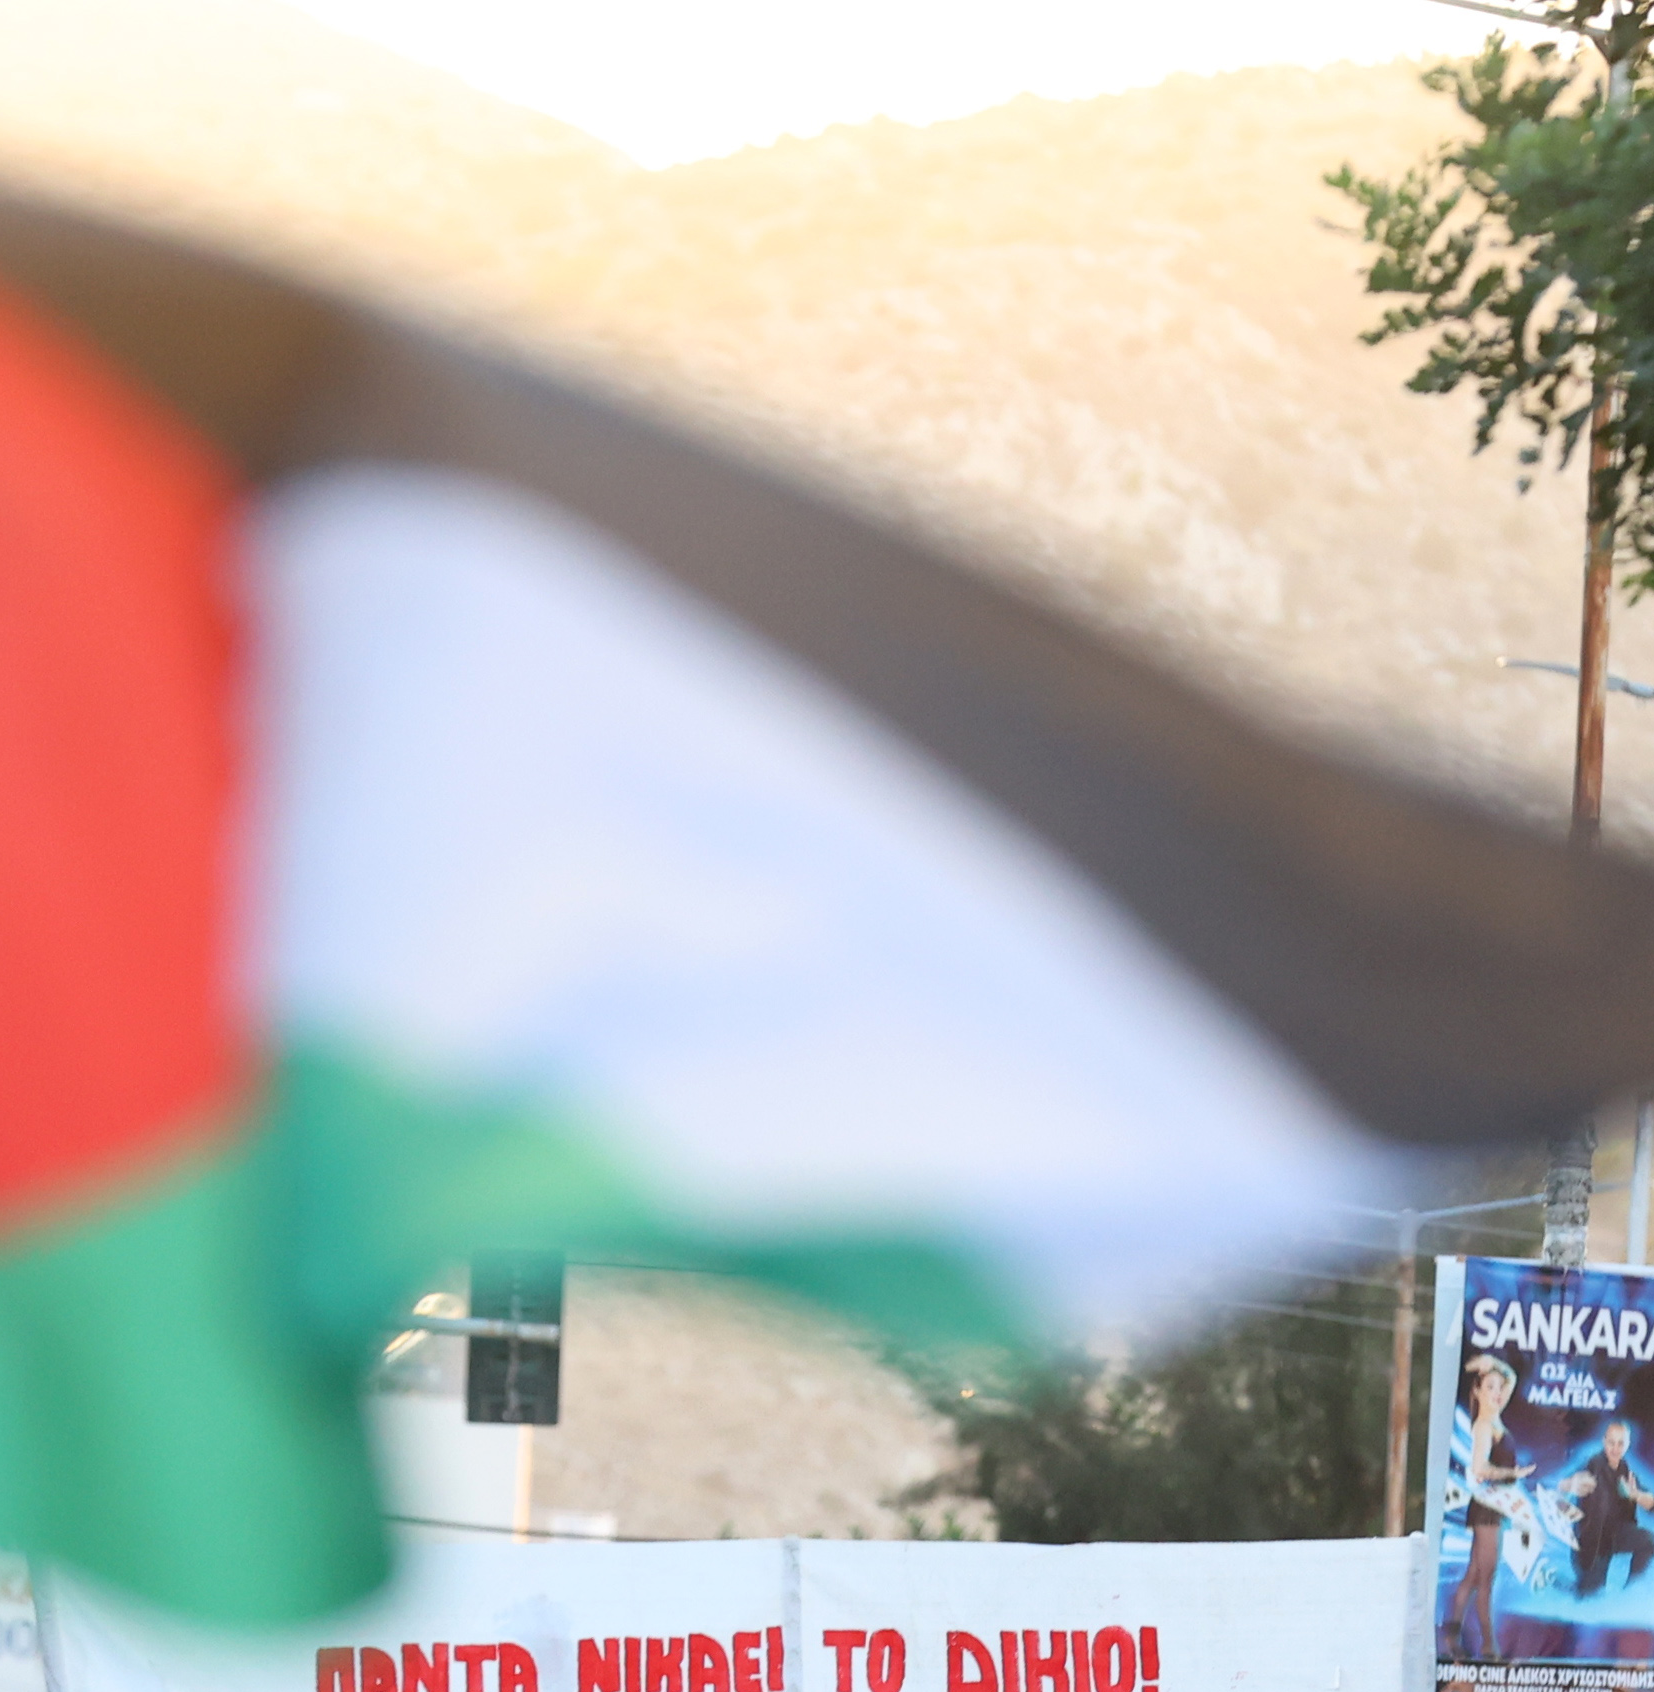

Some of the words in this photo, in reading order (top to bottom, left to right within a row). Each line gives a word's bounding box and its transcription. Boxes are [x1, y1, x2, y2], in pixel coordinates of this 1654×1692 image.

[1565, 1371, 1595, 1390] ΔΙΑ
[1527, 1384, 1617, 1410] ΜΑΓΕΙΑΣ
[1479, 1666, 1507, 1684] CINE
[1507, 1667, 1556, 1686] ΑΛΕΚΟΣ
